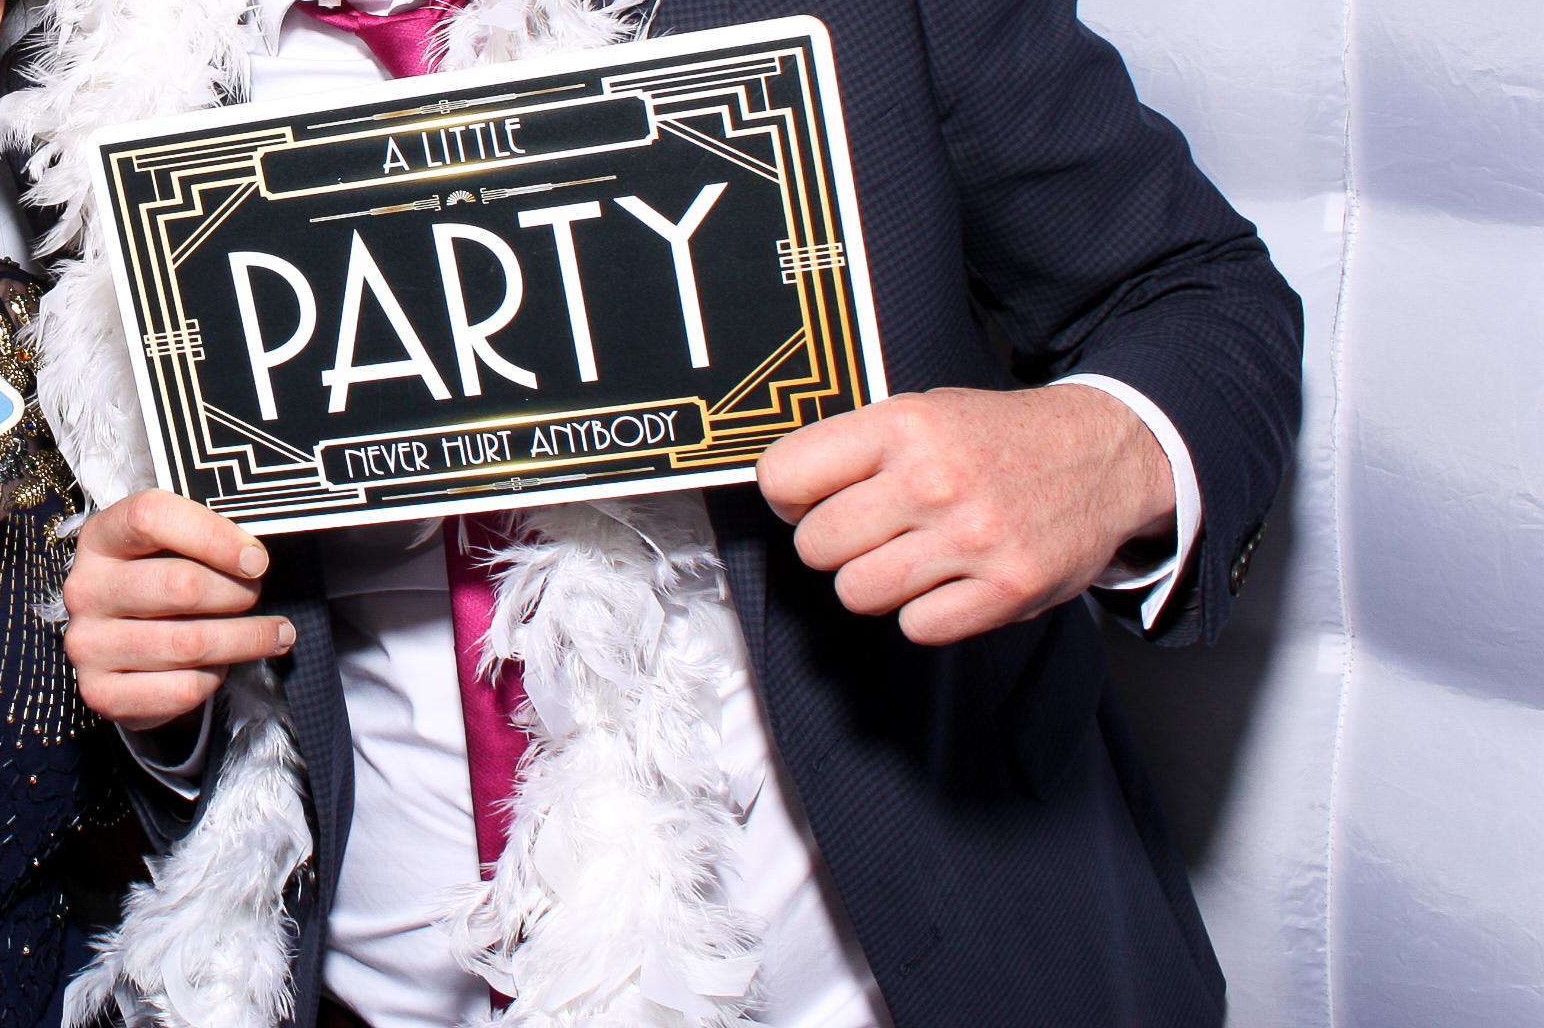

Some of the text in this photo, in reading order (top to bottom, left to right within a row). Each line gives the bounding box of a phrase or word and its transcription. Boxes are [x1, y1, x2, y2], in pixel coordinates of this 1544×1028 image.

[382, 117, 527, 175] A LITTLE
[227, 181, 729, 421] PARTY
[344, 410, 679, 479] NEVER HURT ANYBODY
